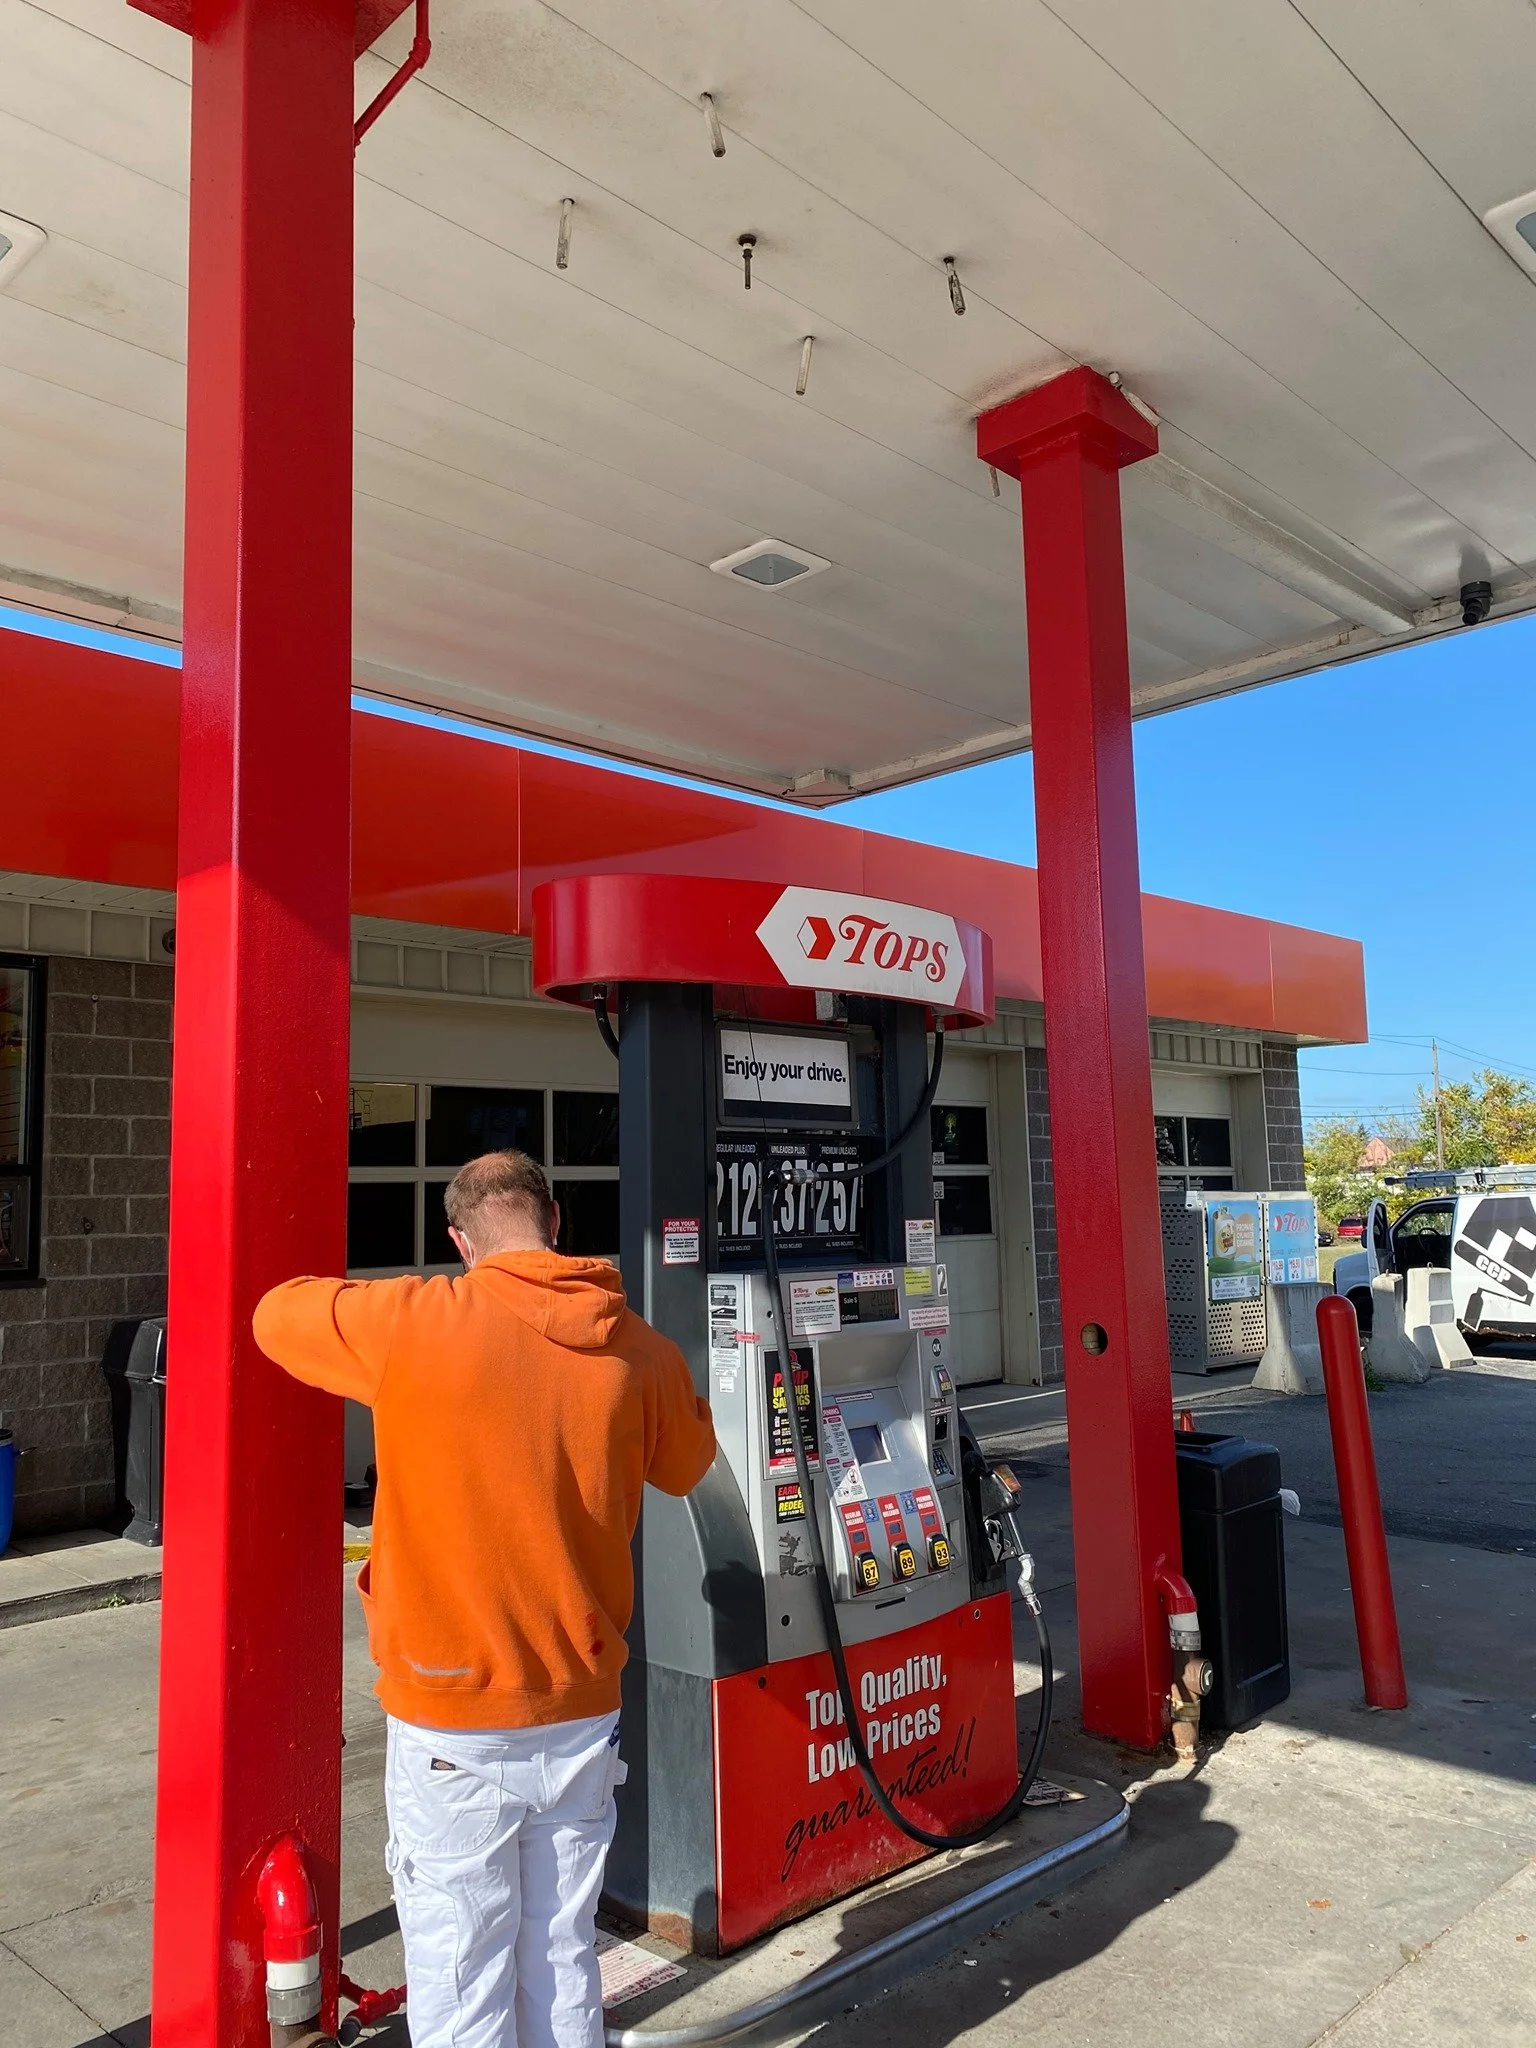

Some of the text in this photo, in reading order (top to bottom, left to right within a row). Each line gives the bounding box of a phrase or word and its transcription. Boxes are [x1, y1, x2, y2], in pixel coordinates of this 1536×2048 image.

[724, 1054, 846, 1082] Enjoy your drive.
[734, 1144, 756, 1154] UNLEADED
[770, 1145, 806, 1155] UNLEADED PLUS
[821, 1146, 857, 1155] PREMIUM UNLEADED
[1475, 1254, 1512, 1283] CCP
[937, 1265, 948, 1295] 2
[932, 1343, 941, 1352] OK
[773, 1370, 809, 1387] PMP
[773, 1386, 785, 1397] UP
[936, 1548, 948, 1560] 93
[901, 1557, 913, 1569] 89
[864, 1566, 876, 1580] 87
[861, 1654, 947, 1714] Quality,
[807, 1703, 941, 1784] Low Prices
[781, 1716, 977, 1883] guarnteed!
